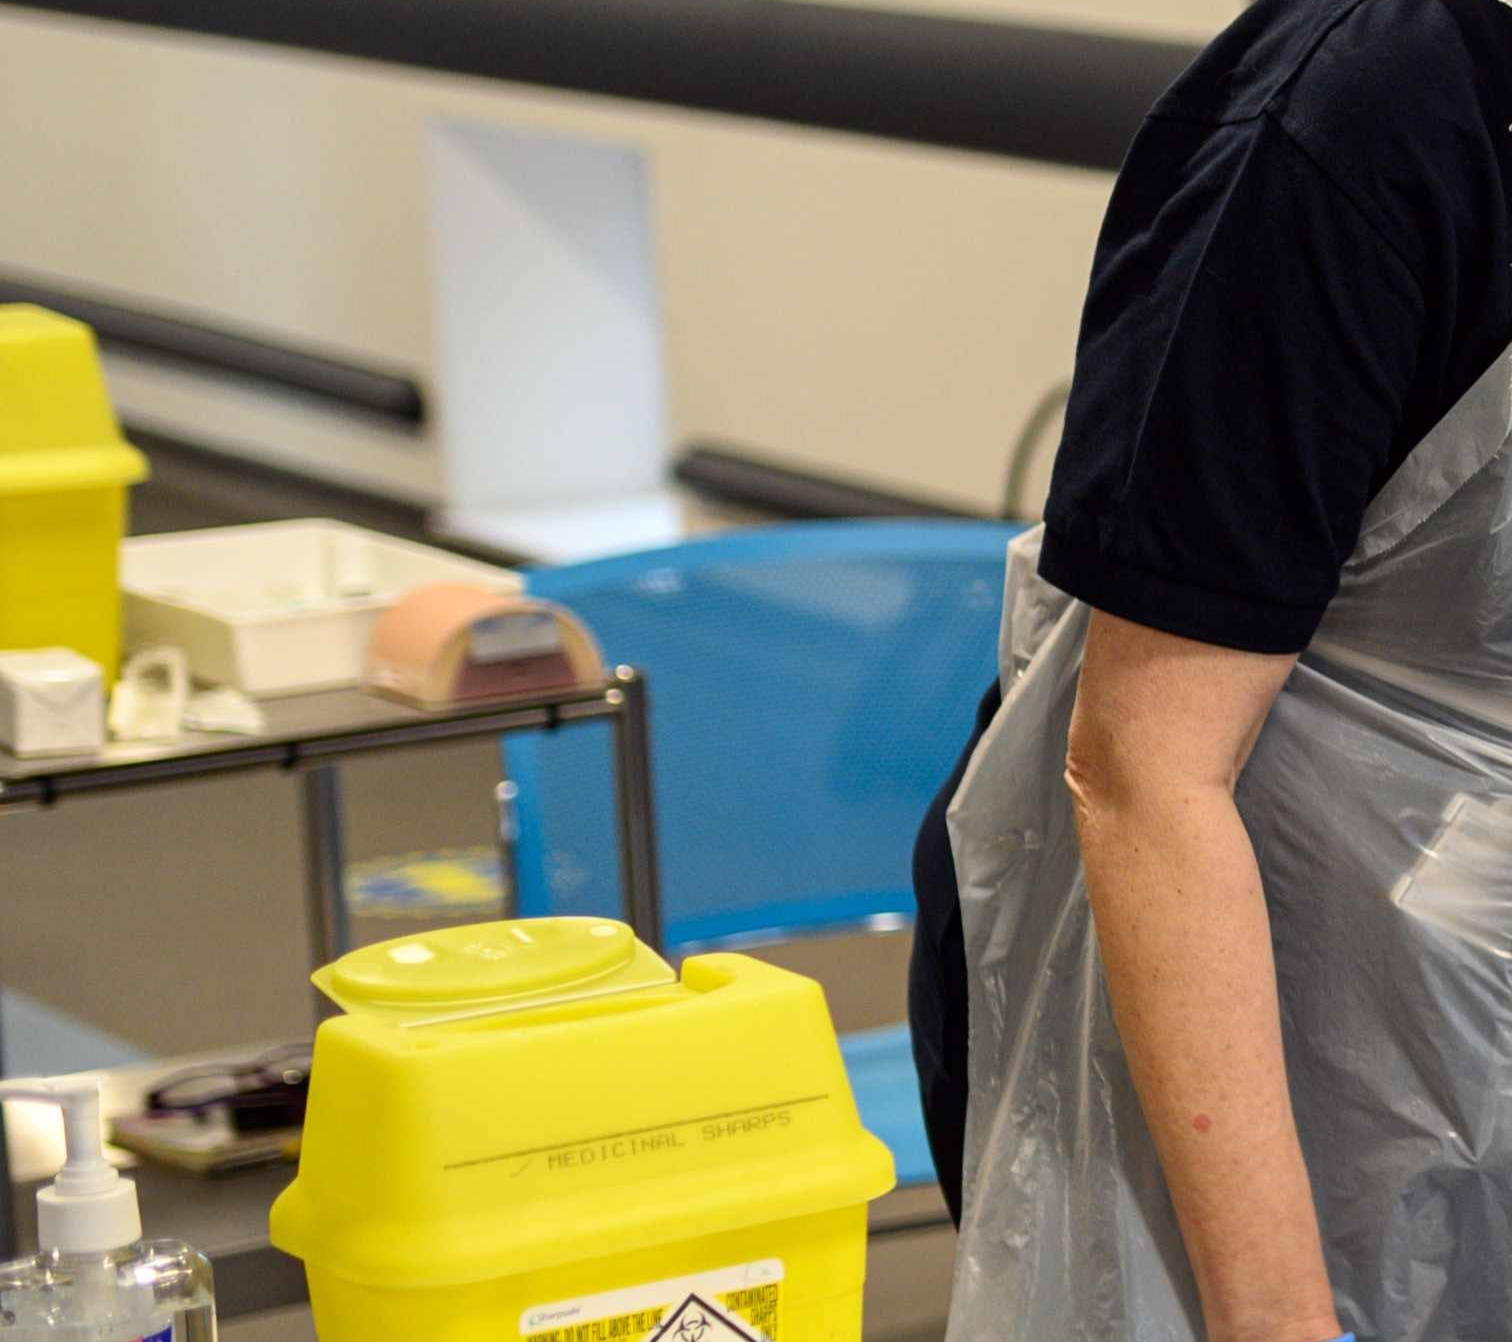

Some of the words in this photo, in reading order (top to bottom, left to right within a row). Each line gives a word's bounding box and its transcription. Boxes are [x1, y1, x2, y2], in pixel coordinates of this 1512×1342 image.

[548, 1129, 686, 1172] MEDICINAL
[701, 1110, 792, 1143] SHARPS
[591, 1319, 607, 1342] FILL
[608, 1314, 632, 1339] ABOVE
[633, 1311, 646, 1334] THE
